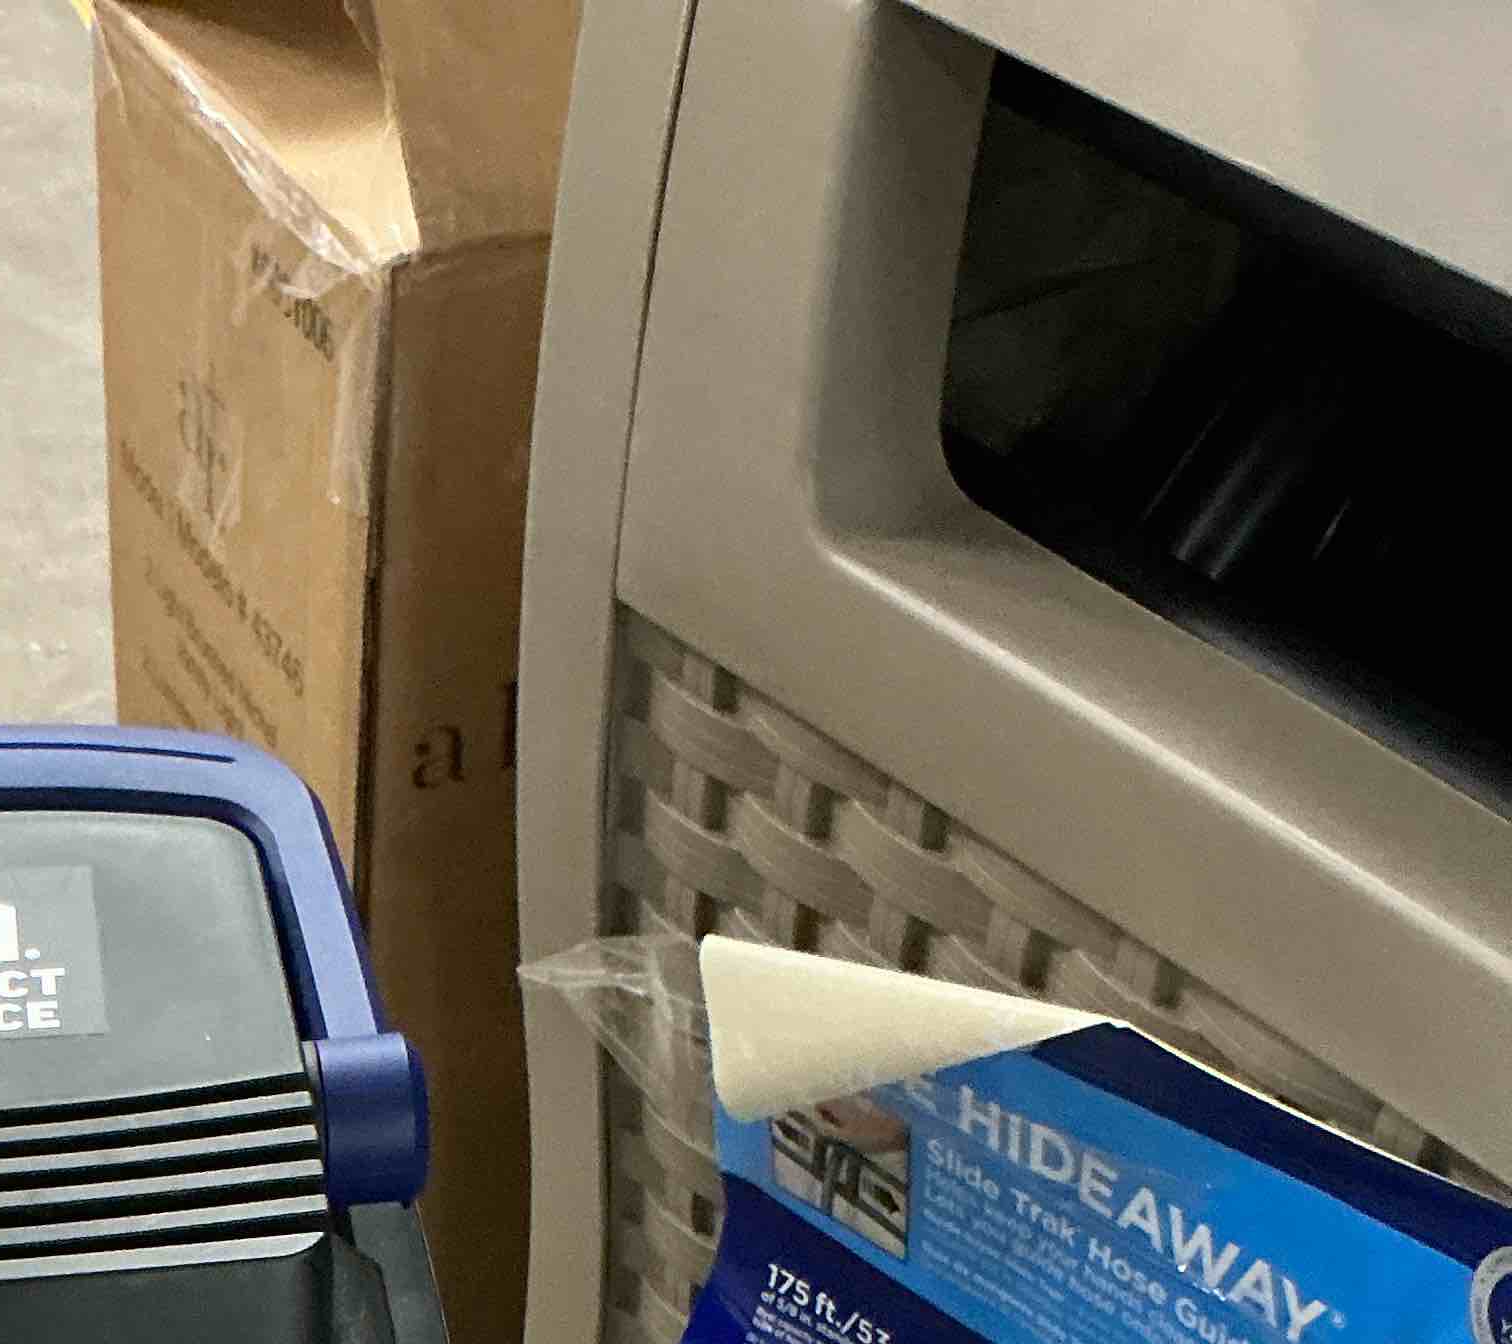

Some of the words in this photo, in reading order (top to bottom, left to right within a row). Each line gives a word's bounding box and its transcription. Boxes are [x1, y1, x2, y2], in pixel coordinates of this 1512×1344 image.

[926, 1136, 1000, 1201] Slide
[1088, 1236, 1168, 1305] Hose
[767, 1263, 811, 1307] 175
